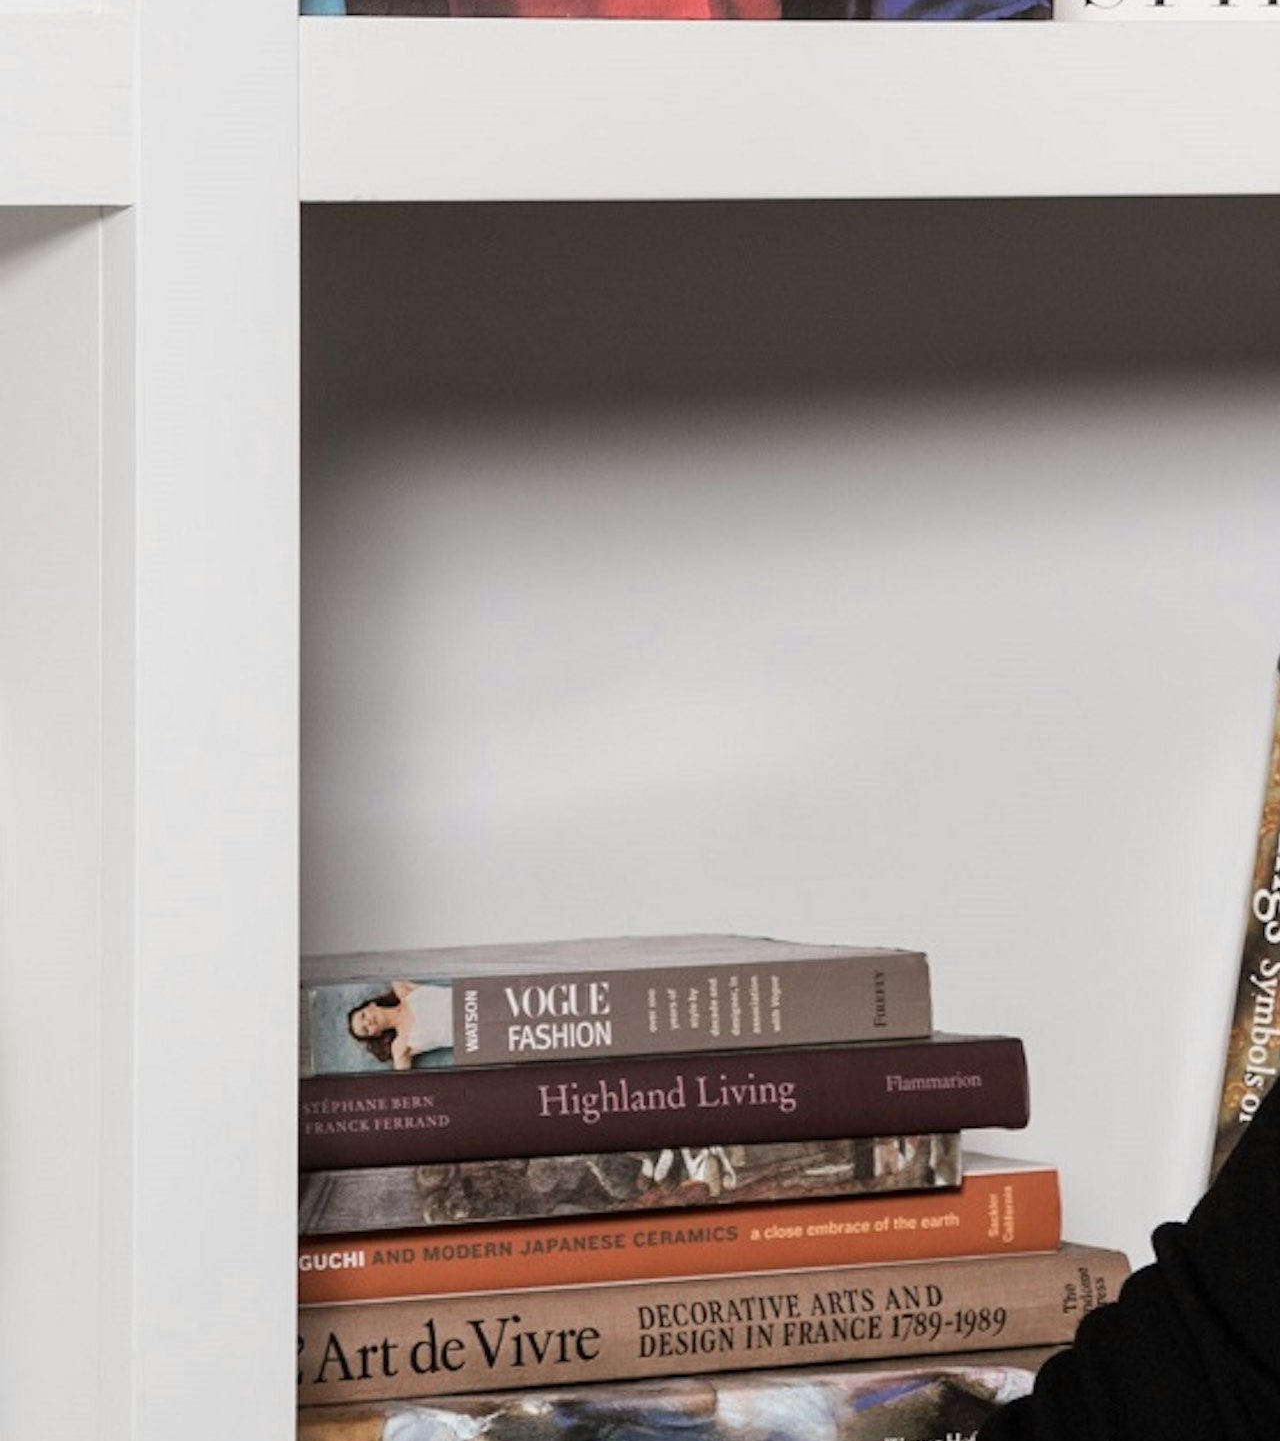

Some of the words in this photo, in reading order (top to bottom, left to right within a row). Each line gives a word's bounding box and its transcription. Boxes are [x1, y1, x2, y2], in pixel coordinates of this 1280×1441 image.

[466, 989, 478, 1054] WATSON
[505, 982, 610, 1017] VOGUE
[508, 1021, 612, 1052] FASHION
[539, 1076, 687, 1124] Highland
[697, 1073, 796, 1112] Living
[886, 1072, 982, 1092] Flammarion
[638, 1297, 802, 1330] DECORATIVE
[811, 1287, 874, 1317] ARTS
[885, 1284, 944, 1310] AND
[638, 1327, 736, 1358] DESIGN
[746, 1326, 774, 1350] IN
[784, 1316, 882, 1346] FRANCE
[891, 1307, 1007, 1342] 1789-1989
